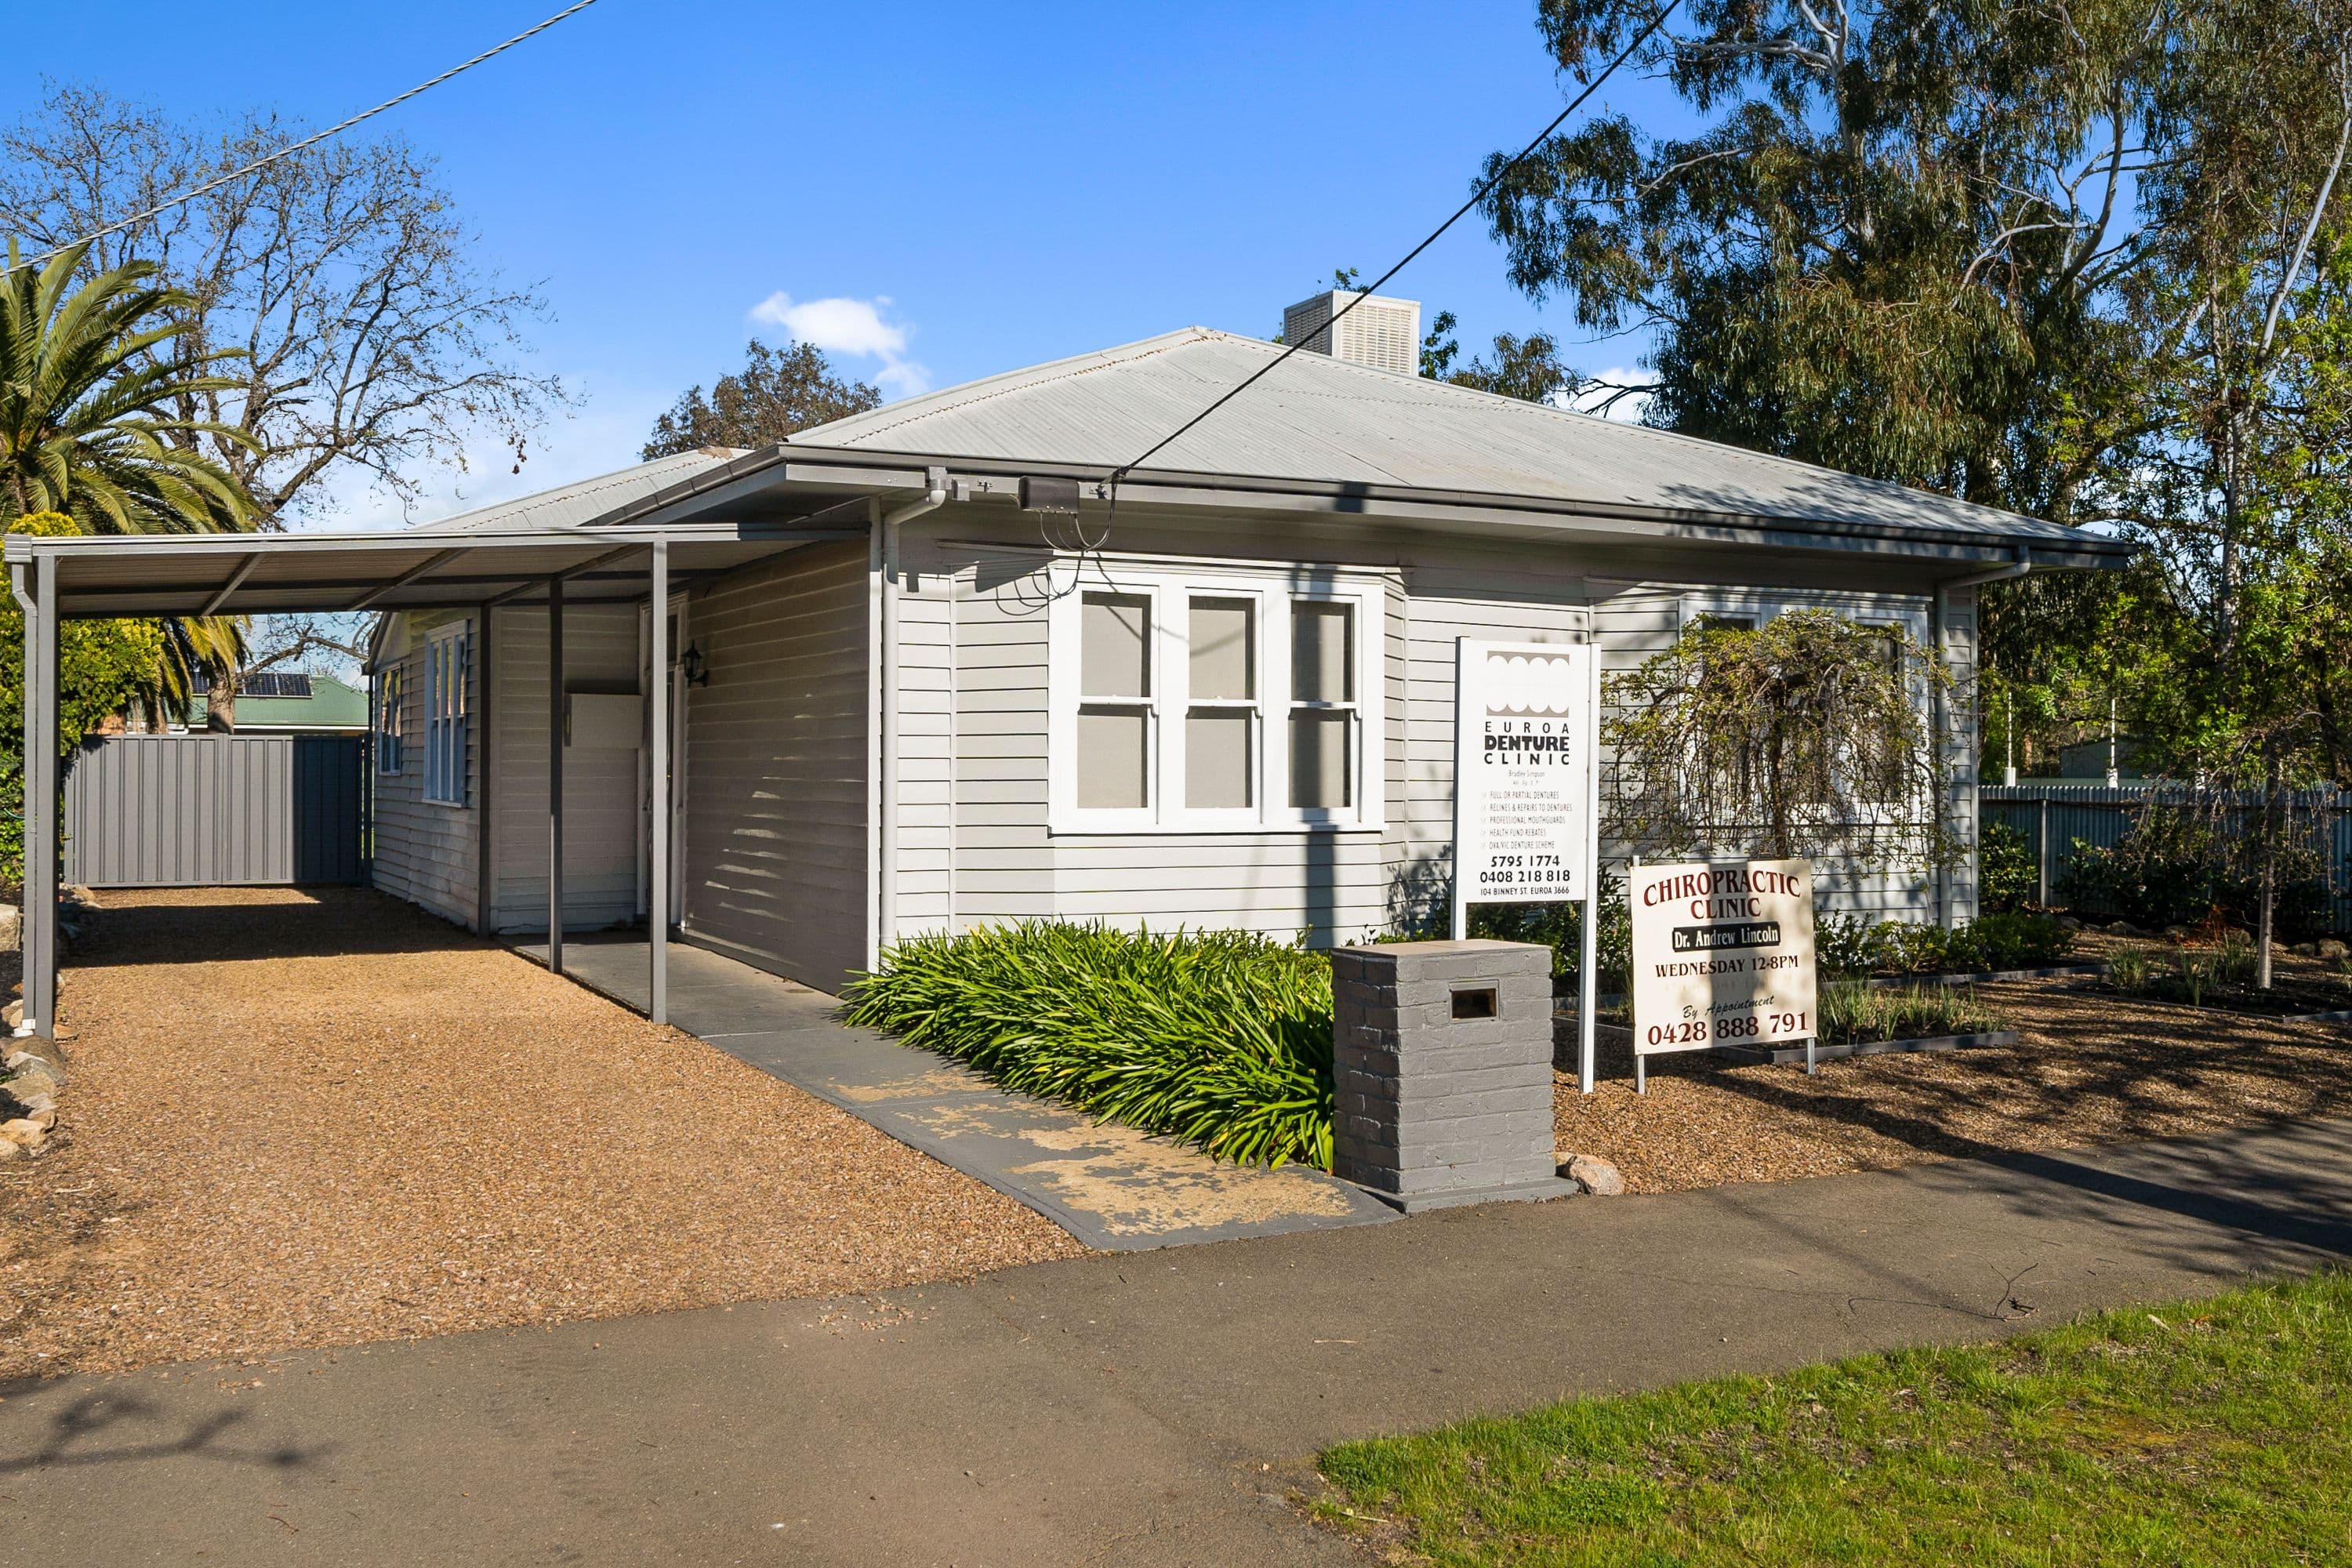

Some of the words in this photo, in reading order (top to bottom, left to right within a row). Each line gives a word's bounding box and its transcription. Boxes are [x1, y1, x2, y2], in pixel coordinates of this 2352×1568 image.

[1485, 721, 1569, 734] EUROA
[1484, 735, 1570, 751] DENTURE
[1484, 753, 1570, 765] CLINIC
[1491, 856, 1523, 867] 5795
[1530, 855, 1560, 866] 1774
[1480, 871, 1513, 883] 0408
[1518, 870, 1542, 882] 218
[1547, 869, 1570, 881] 818
[1530, 887, 1552, 895] EUROA
[1554, 886, 1569, 895] 3666
[1643, 869, 1801, 907] CHIROPRACTIC
[1690, 898, 1761, 919] CLINIC
[1675, 931, 1690, 949] Dr.
[1696, 929, 1735, 947] Andrew
[1741, 926, 1778, 944] Lincoln
[1655, 959, 1745, 978] WEDNESDAY
[1751, 955, 1798, 971] 12-8PM
[1683, 1005, 1698, 1020] By
[1705, 995, 1775, 1016] Appointment
[1648, 1021, 1707, 1045] 0428
[1715, 1017, 1759, 1039] 888
[1769, 1011, 1808, 1033] 791
